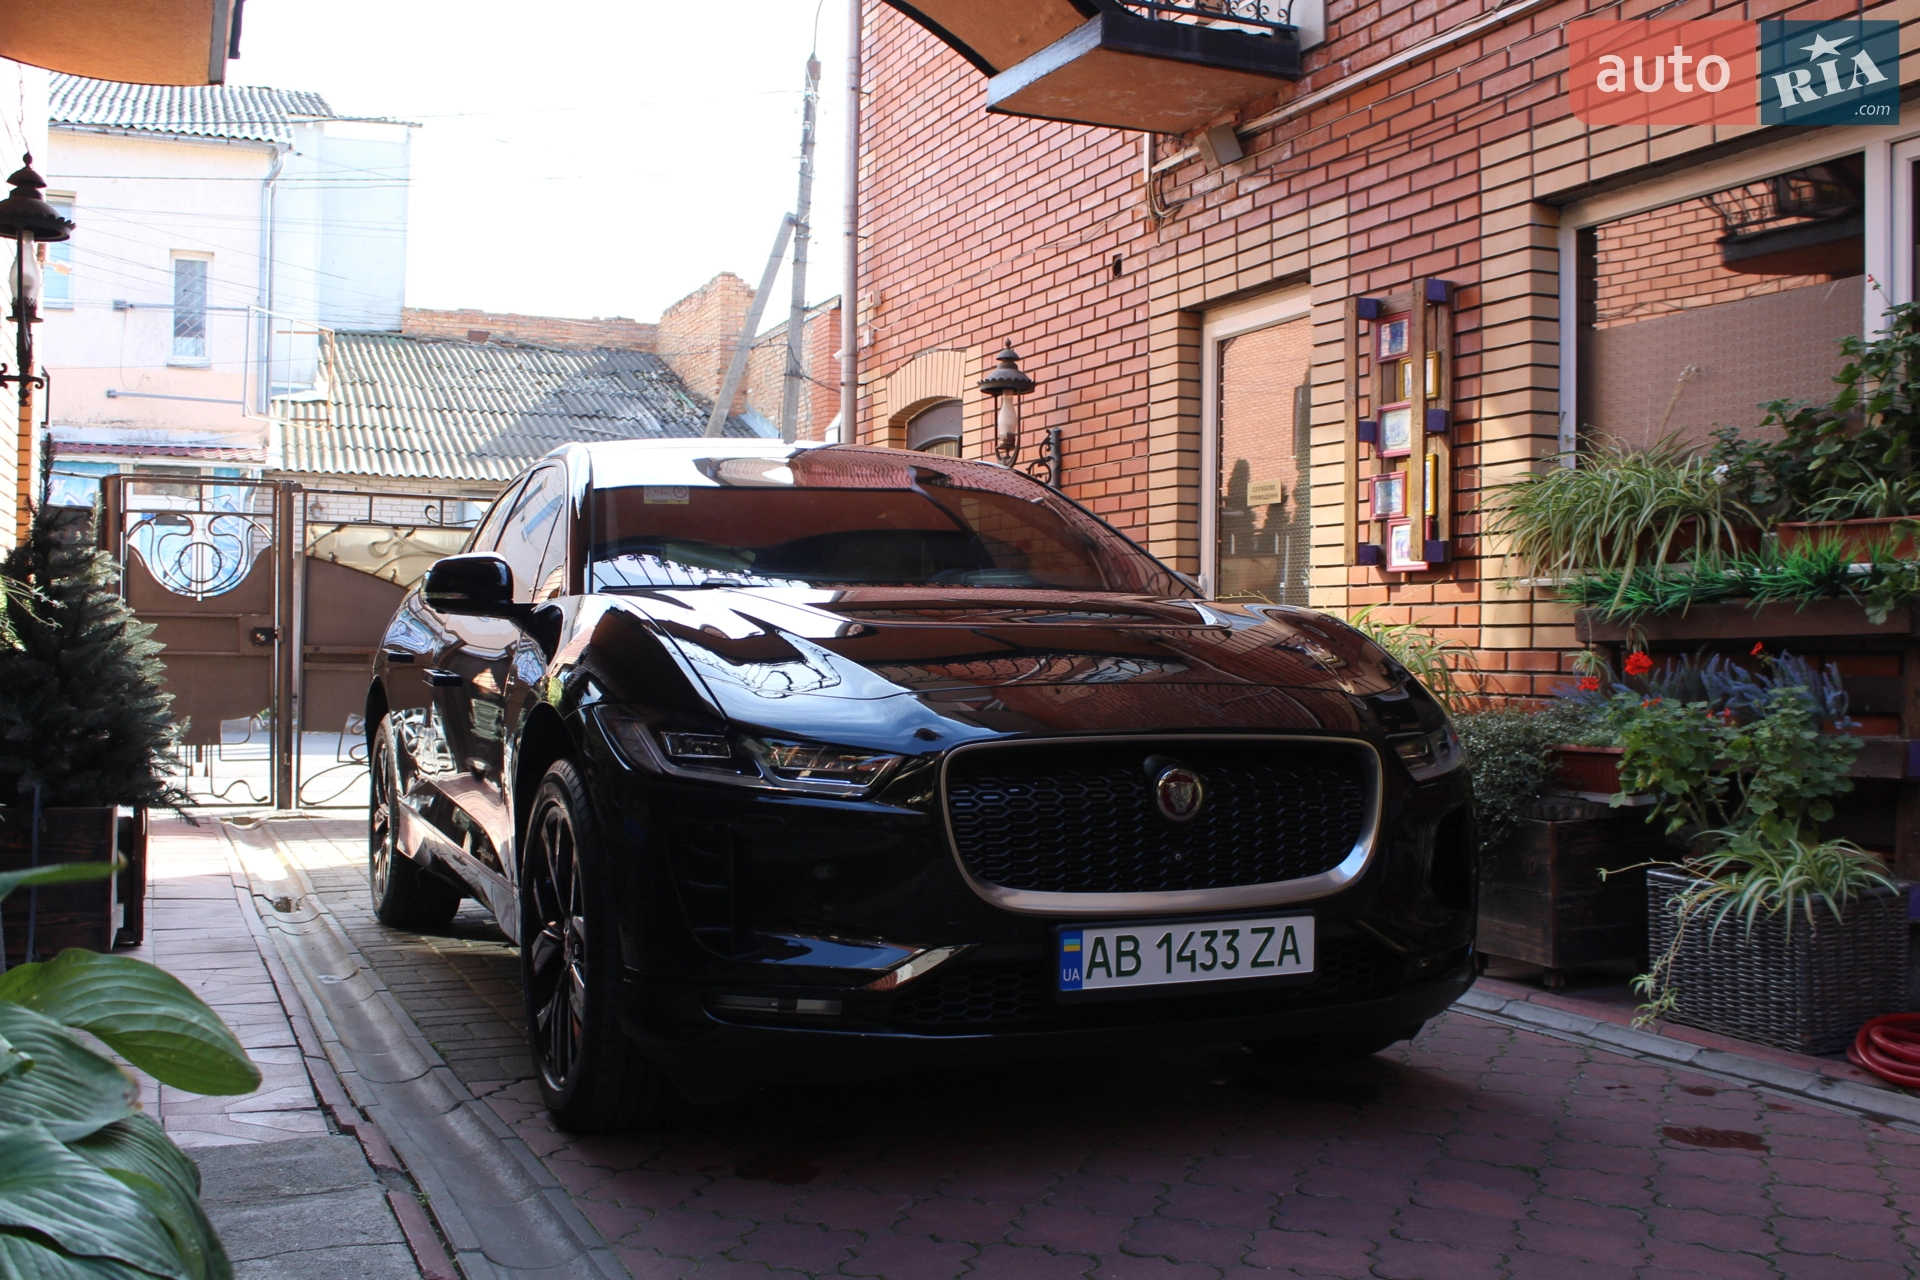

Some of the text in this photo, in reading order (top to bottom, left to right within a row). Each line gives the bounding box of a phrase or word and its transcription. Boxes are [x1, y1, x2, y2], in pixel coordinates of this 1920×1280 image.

[1085, 925, 1302, 980] AB 1433 ZA
[1063, 967, 1081, 982] UA
